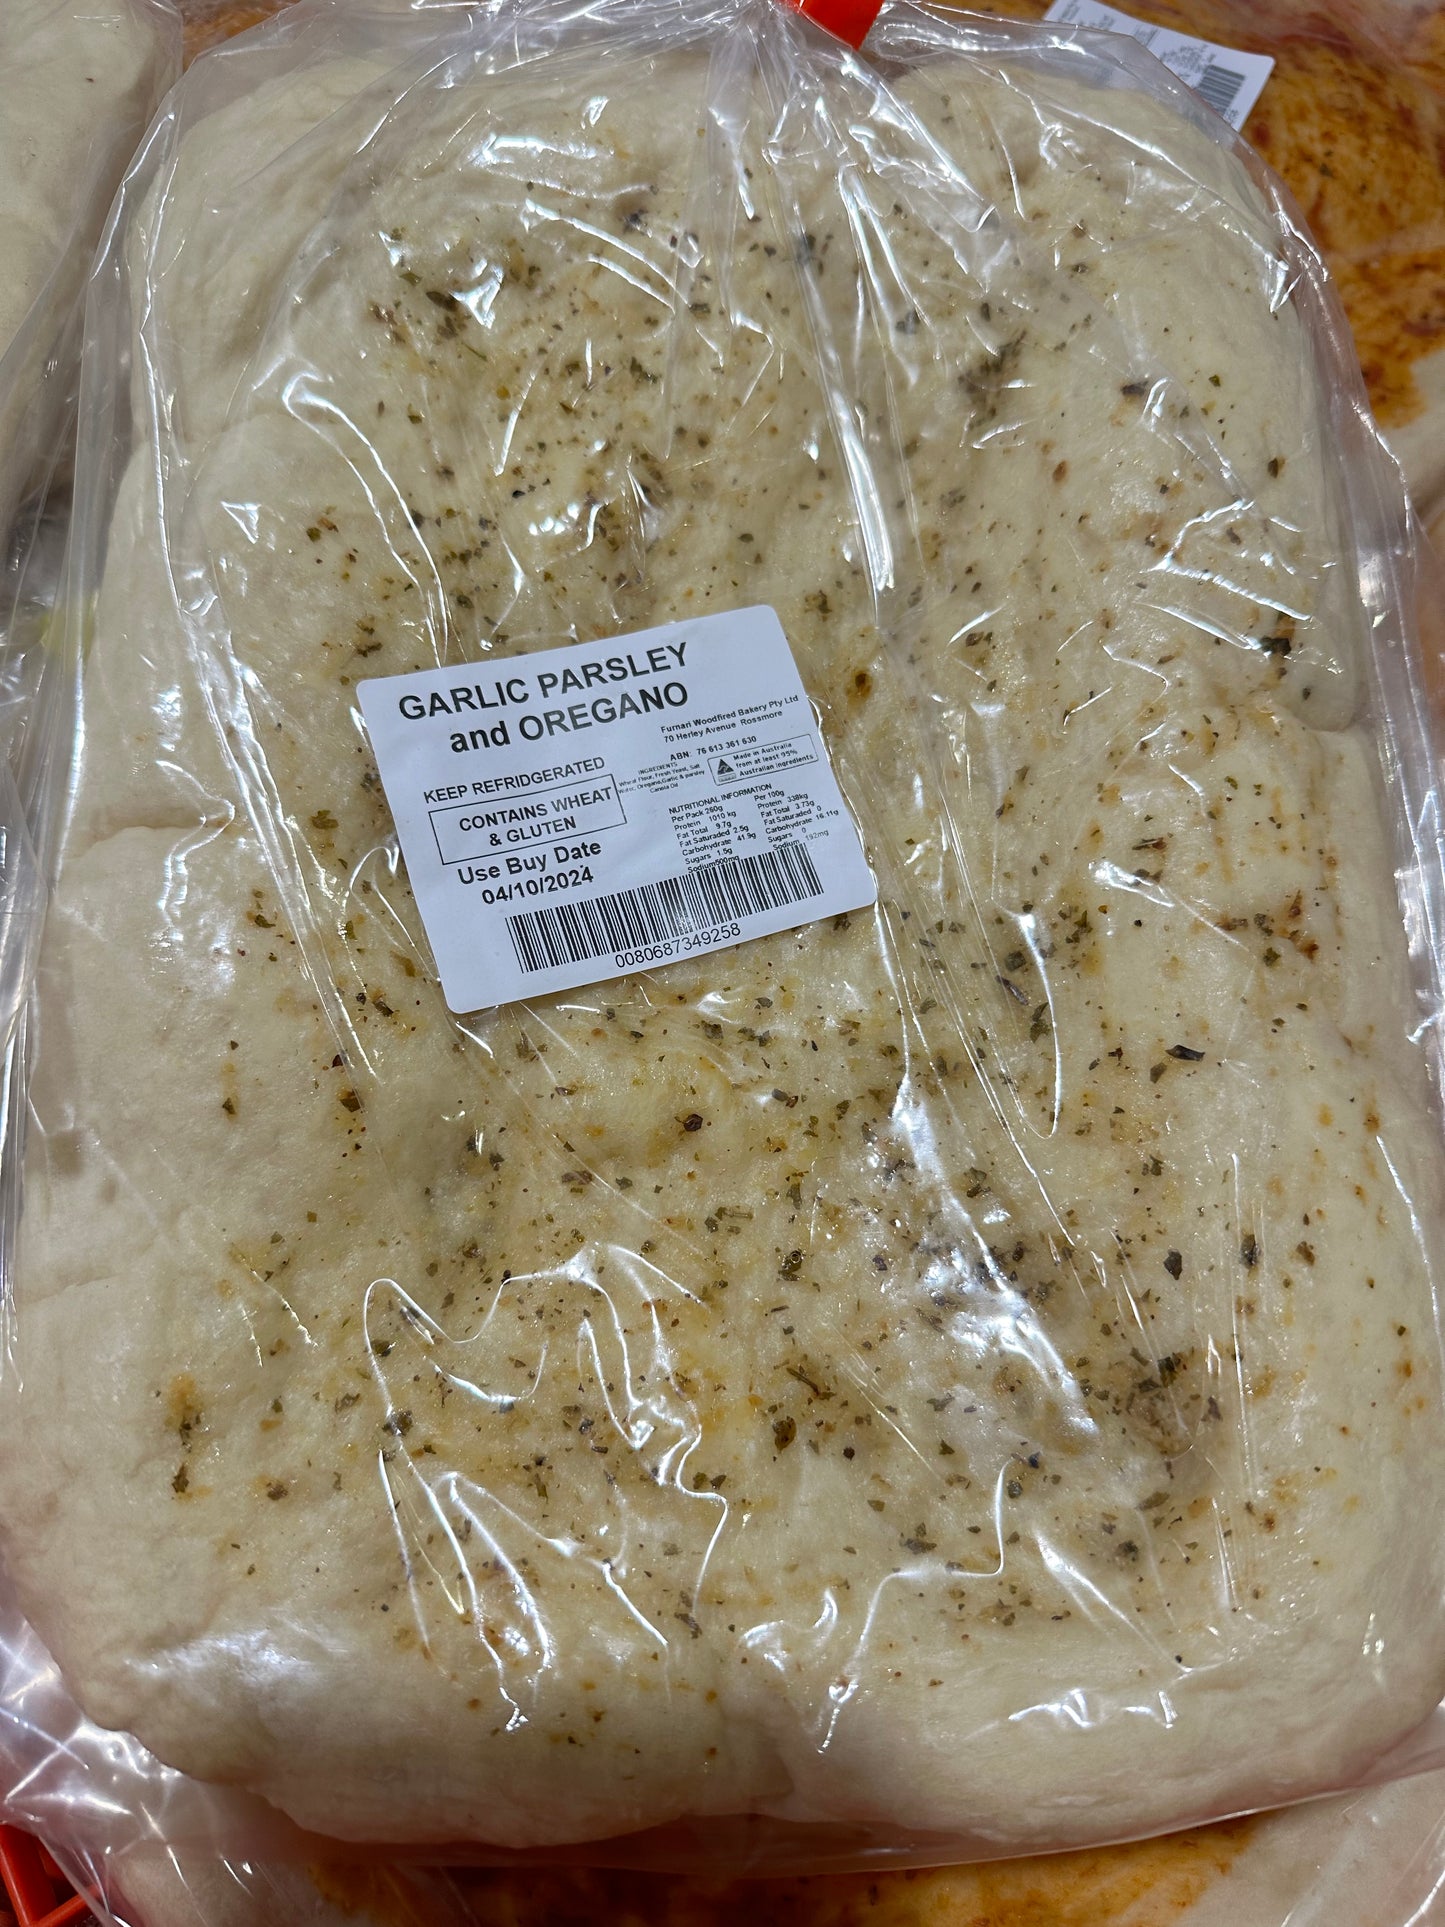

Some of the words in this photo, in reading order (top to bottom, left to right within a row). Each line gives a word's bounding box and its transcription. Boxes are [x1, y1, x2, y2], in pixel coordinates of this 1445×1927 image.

[399, 679, 529, 720] GARLIC
[537, 642, 686, 698] PARSLEY
[450, 721, 511, 753] and
[519, 682, 688, 741] OREGANO
[693, 711, 736, 726] Woodfired
[738, 703, 767, 716] Bakery
[769, 699, 783, 709] Pty
[785, 695, 799, 704] Ltd
[664, 735, 674, 743] 70
[676, 728, 703, 740] Herley
[705, 722, 737, 734] Avenue
[740, 710, 783, 726] Rossmore
[670, 750, 692, 761] ABN:
[696, 747, 707, 755] 76
[709, 744, 724, 753] 613
[726, 739, 740, 748] 361
[742, 735, 757, 744] 630
[733, 753, 751, 761] Made
[761, 743, 792, 754] Australia
[736, 760, 752, 768] from
[762, 754, 779, 763] least
[781, 749, 798, 757] 95%
[638, 761, 678, 775] INGREDIENTS
[655, 769, 671, 778] Fresh
[740, 764, 774, 776] Australian
[776, 754, 814, 768] ingredients
[423, 784, 468, 804] KEEP
[471, 756, 606, 795] REFRIDGERATED
[650, 785, 670, 793] Canola
[669, 796, 720, 814] NUTRITIONAL
[721, 783, 772, 800] INFORMATION
[754, 793, 766, 801] Per
[768, 790, 785, 798] 100g
[757, 799, 782, 809] Protein
[459, 803, 548, 831] CONTAINS
[551, 786, 612, 813] WHEAT
[671, 814, 684, 823] Per
[685, 810, 704, 819] Pack
[705, 805, 723, 815] 260g
[760, 810, 773, 818] Fat
[773, 806, 790, 814] Total
[795, 800, 815, 809] 3.73g
[763, 818, 775, 826] Fat
[776, 809, 812, 822] Saturaded
[489, 833, 502, 846] &
[506, 816, 577, 843] GLUTEN
[674, 820, 701, 831] Protein
[709, 812, 726, 821] 1010
[727, 810, 737, 818] kg
[676, 831, 689, 840] Fat
[690, 826, 708, 836] Total
[716, 821, 732, 829] 9.7g
[765, 817, 812, 834] Carbohydrate
[816, 809, 839, 820] 16.11g
[679, 839, 692, 847] Fat
[693, 829, 730, 844] Saturaded
[733, 825, 749, 833] 2.5g
[682, 838, 732, 856] Carbohydrate
[737, 832, 756, 841] 41.9g
[767, 832, 793, 843] Sugars
[773, 839, 800, 851] Sodium
[457, 865, 501, 885] Use
[505, 854, 547, 875] Buy
[553, 841, 602, 864] Date
[685, 853, 711, 865] Sugars
[717, 847, 733, 856] 1.5g
[481, 866, 594, 905] 04/10/2024
[615, 922, 741, 968] 0080687349258
